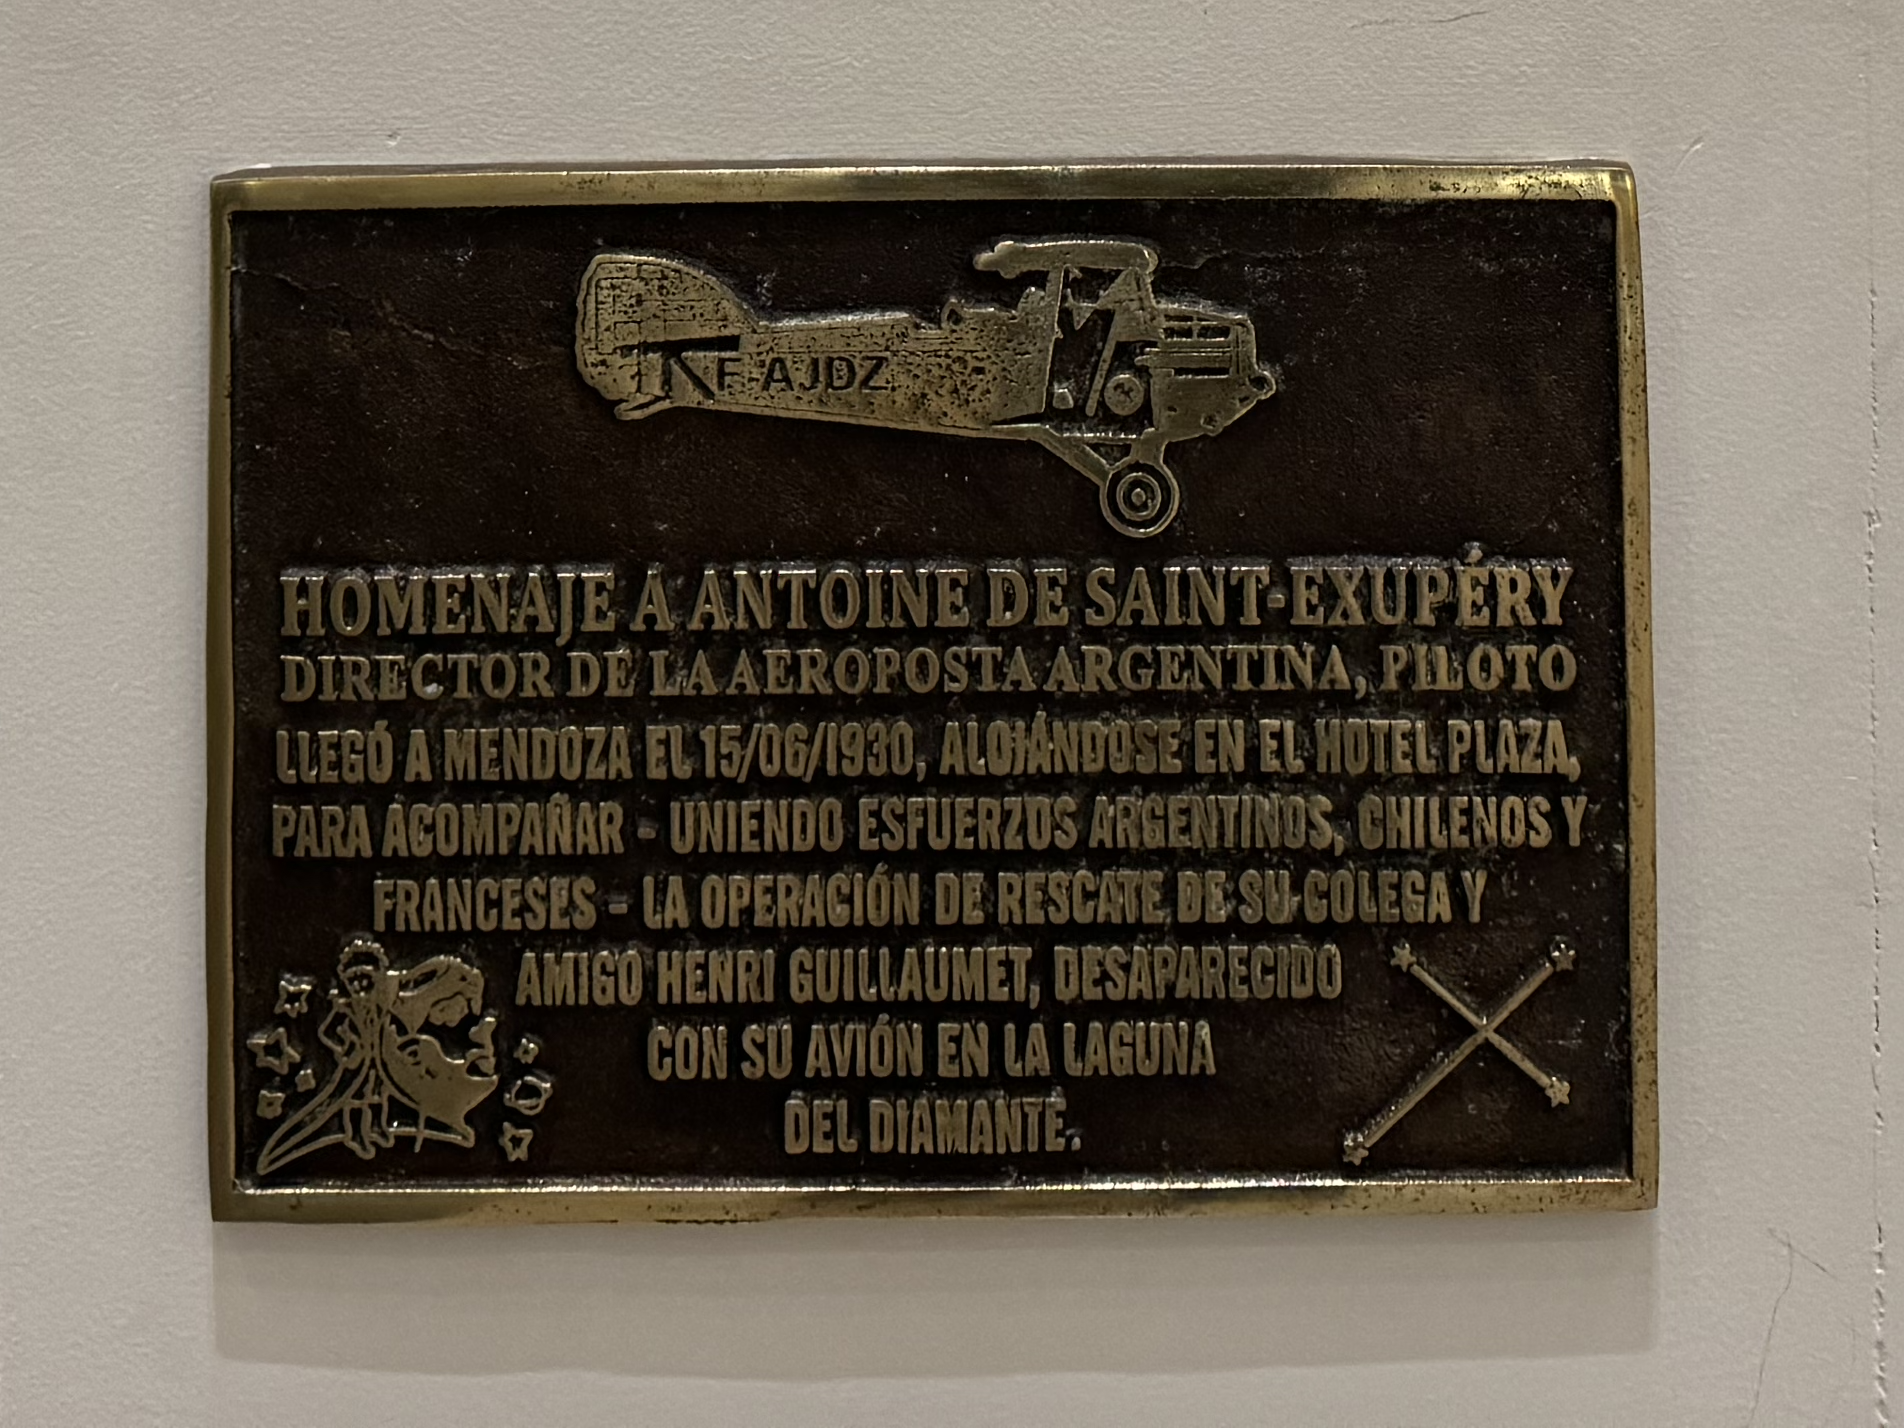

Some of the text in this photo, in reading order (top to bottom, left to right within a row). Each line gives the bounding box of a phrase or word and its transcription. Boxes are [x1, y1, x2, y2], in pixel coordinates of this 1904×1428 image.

[280, 547, 1573, 646] HOMENAJE A ANTOINE DE SAINT-EXUPÉRY
[280, 643, 1578, 702] DIRECTOR DE LA AEROPOSTA ARGENTINA, PILOTO
[276, 711, 1582, 784] LLEGÓ A MENDOZA EL 15/06/1930, ALOJÁNDOSE EN EL HOTEL PLAZA,
[272, 803, 374, 858] PARA
[381, 792, 625, 858] ACOMPAÑAR
[669, 798, 844, 853] UNIENDO
[858, 796, 1079, 851] ESFUERZOS
[1088, 794, 1345, 857] ARGENTINOS,
[1357, 794, 1553, 850] CHILENOS
[1561, 795, 1589, 848] Y
[372, 876, 597, 933] FRANCESES
[642, 875, 691, 930] LA
[700, 862, 921, 929] OPERACIÓN
[935, 872, 985, 927] DE
[997, 870, 1166, 926] RESCATE
[1177, 870, 1228, 925] DE
[1238, 869, 1293, 924] SU
[1303, 869, 1453, 924] COLEGA
[1460, 869, 1488, 924] Y
[515, 944, 1343, 1009] AMIGO HENRI GUILLAUMET, DESAPARECIDO
[647, 1013, 1217, 1082] CON SU AVIÓN EN LA LAGUNA
[784, 1096, 1082, 1155] DEL DIAMANTE.
